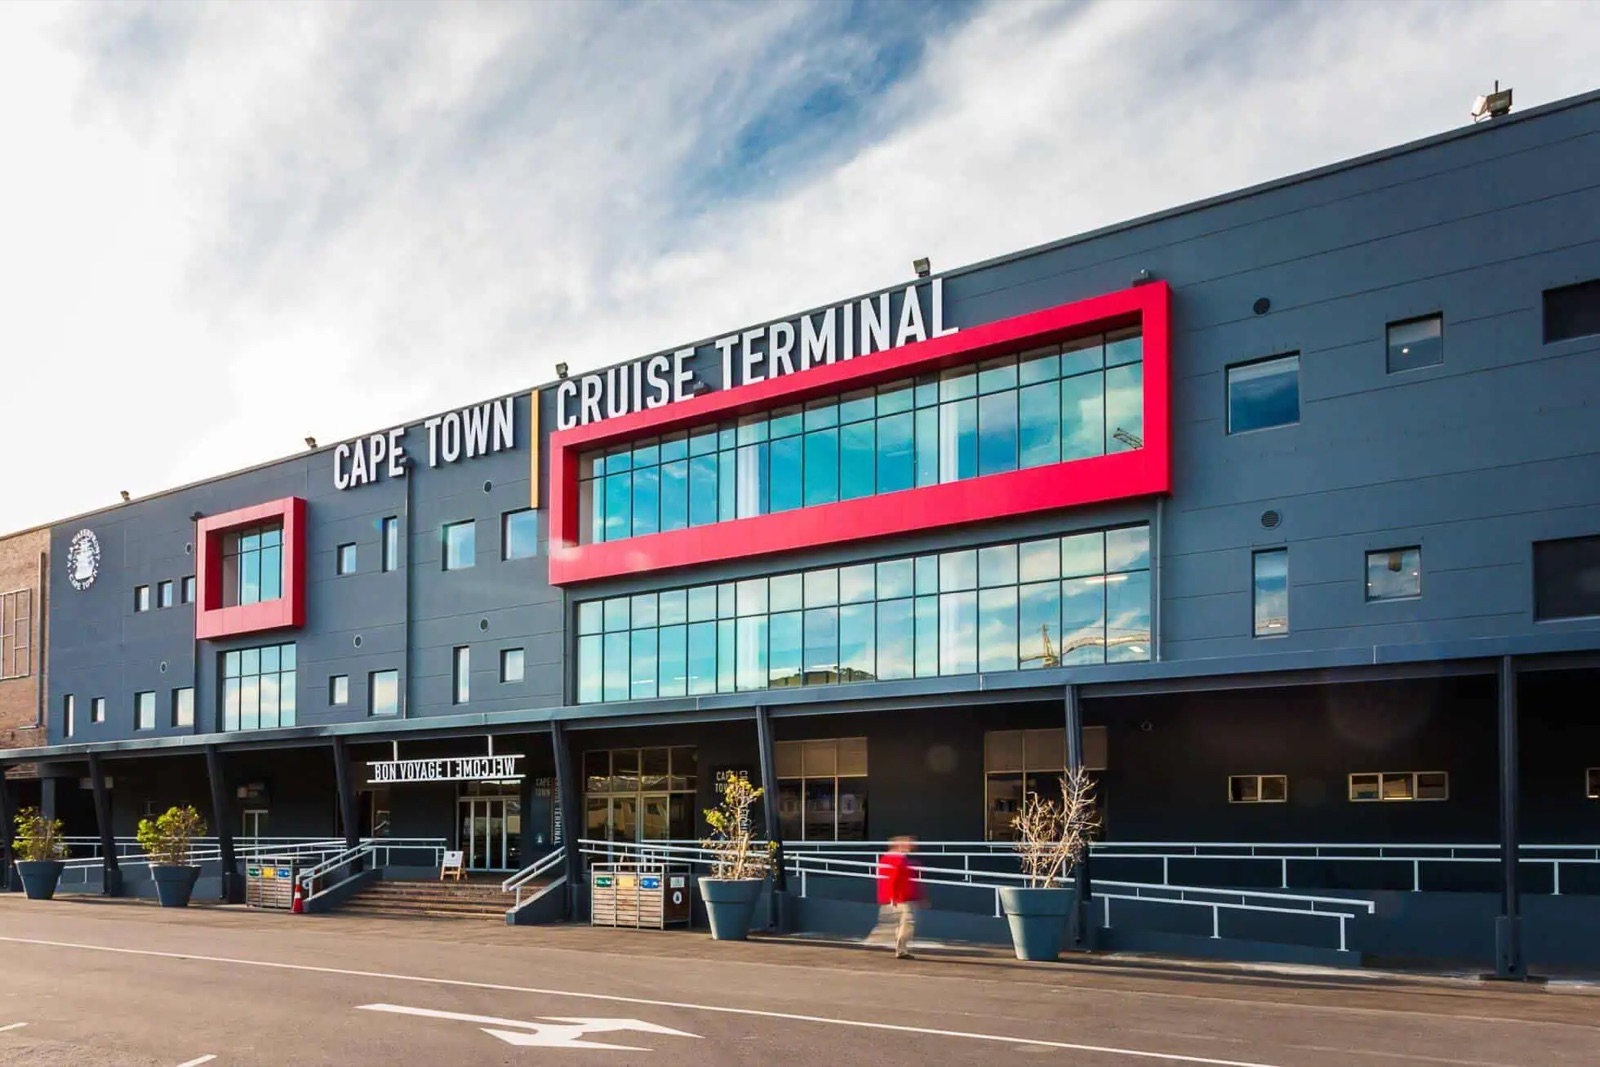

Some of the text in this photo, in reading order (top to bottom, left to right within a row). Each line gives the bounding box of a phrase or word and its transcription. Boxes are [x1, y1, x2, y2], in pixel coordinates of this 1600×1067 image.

[557, 278, 959, 431] CRUISE TERMINAL
[334, 397, 513, 490] CAPE TOWN
[375, 761, 442, 781] BON VOYAGE
